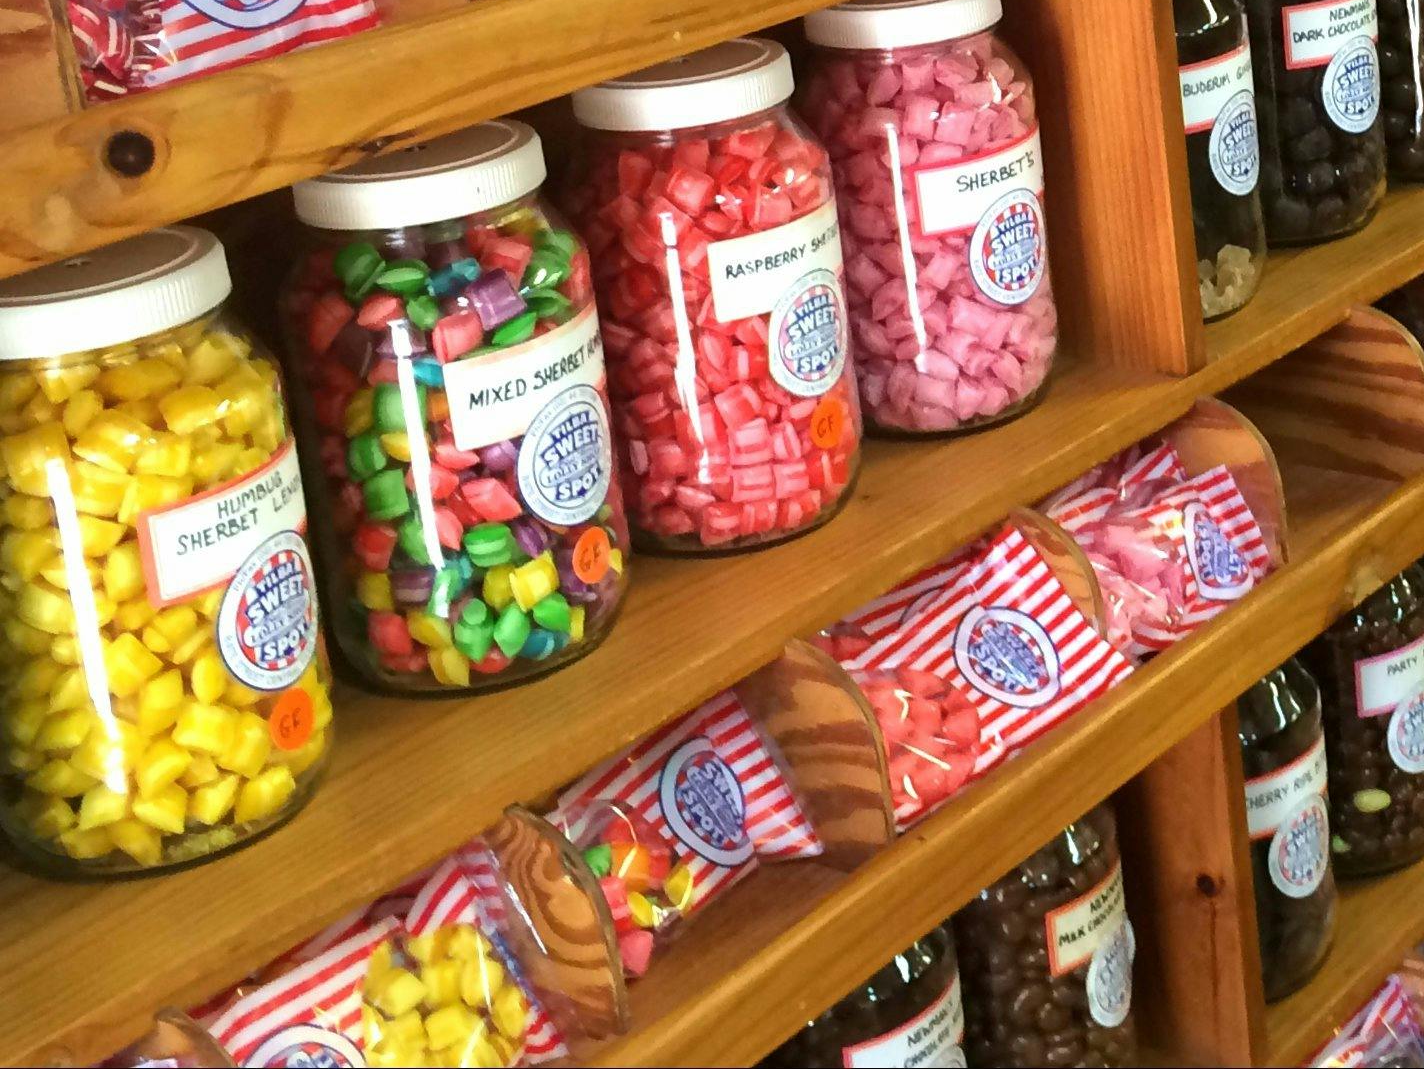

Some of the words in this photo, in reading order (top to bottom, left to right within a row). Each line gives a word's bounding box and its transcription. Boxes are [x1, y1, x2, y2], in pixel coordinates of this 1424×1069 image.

[1293, 28, 1325, 43] DARK
[1182, 73, 1230, 98] BUDERIM
[1339, 65, 1374, 90] SWEET
[1346, 94, 1374, 114] SPOT
[1000, 212, 1030, 232] TILBA
[991, 222, 1036, 254] SWEET
[725, 243, 807, 280] RASPBERRY
[1000, 257, 1036, 282] SPOT
[799, 294, 829, 315] TILBA
[789, 306, 837, 337] SWEET
[799, 345, 838, 374] SPOT
[469, 378, 528, 412] MIXED
[533, 346, 587, 392] SHERBET
[552, 411, 591, 439] TILBA
[543, 423, 600, 468] SWEET
[217, 470, 283, 522] HUMBUG
[556, 466, 602, 502] SPOT
[176, 507, 260, 556] SHERBET
[246, 575, 305, 628] SWEET
[263, 620, 310, 662] SPOT
[1387, 656, 1418, 676] PARTY
[1250, 785, 1290, 810] HERRY
[683, 788, 726, 846] SPOT
